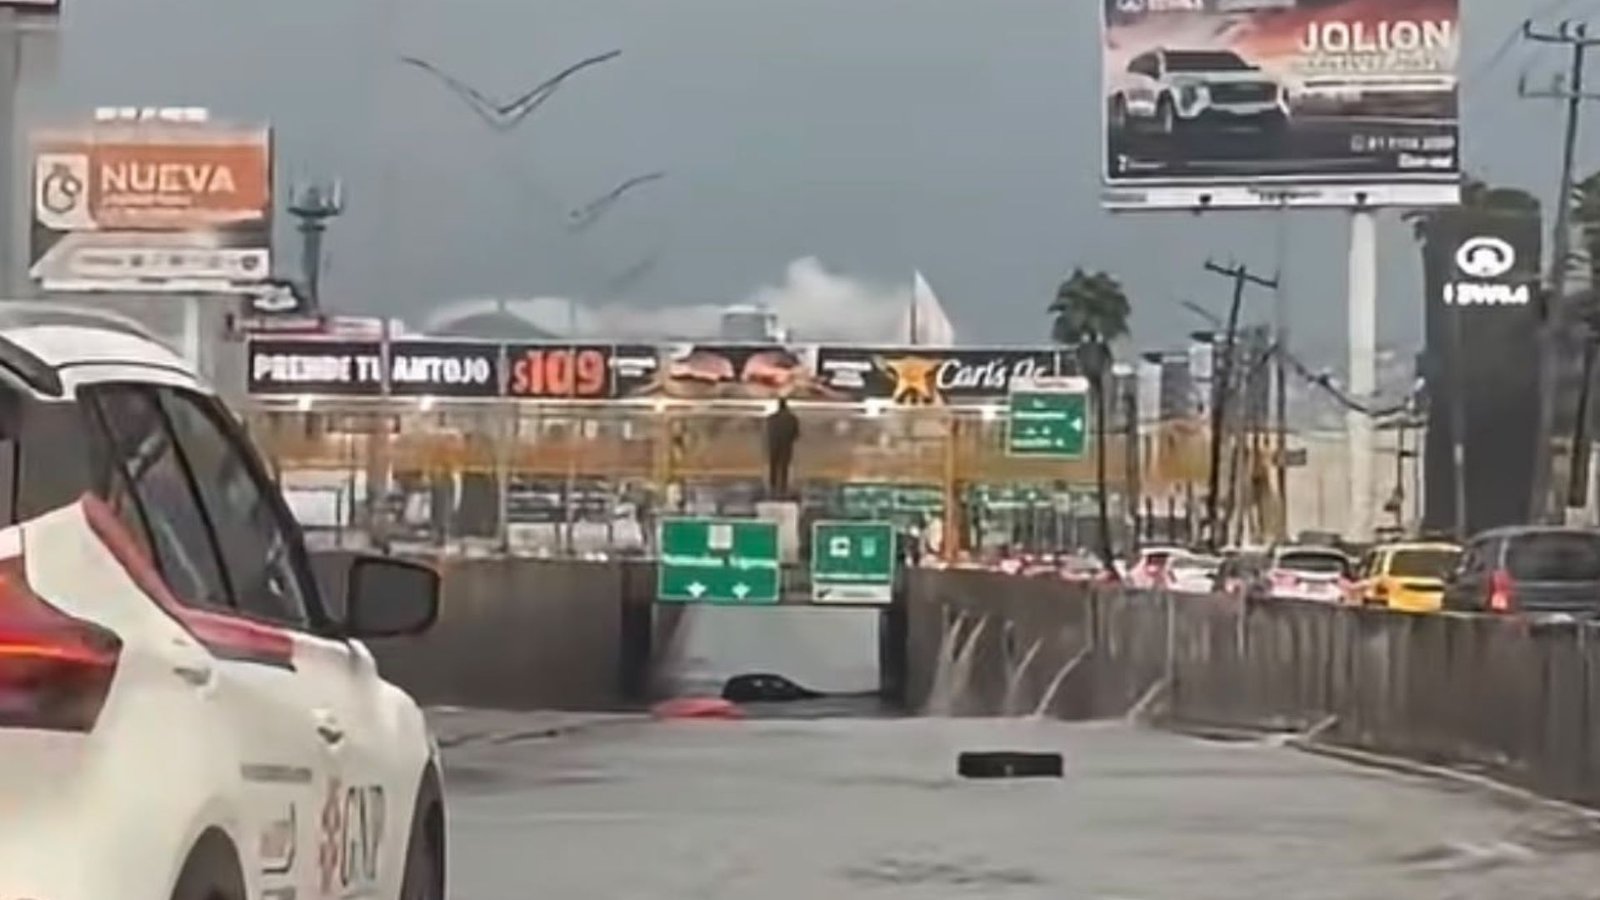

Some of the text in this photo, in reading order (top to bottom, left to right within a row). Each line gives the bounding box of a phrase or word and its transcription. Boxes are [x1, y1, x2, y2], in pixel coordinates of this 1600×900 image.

[1300, 20, 1450, 51] JOLION
[101, 163, 236, 193] NUEVA
[393, 356, 490, 383] ANTOJO
